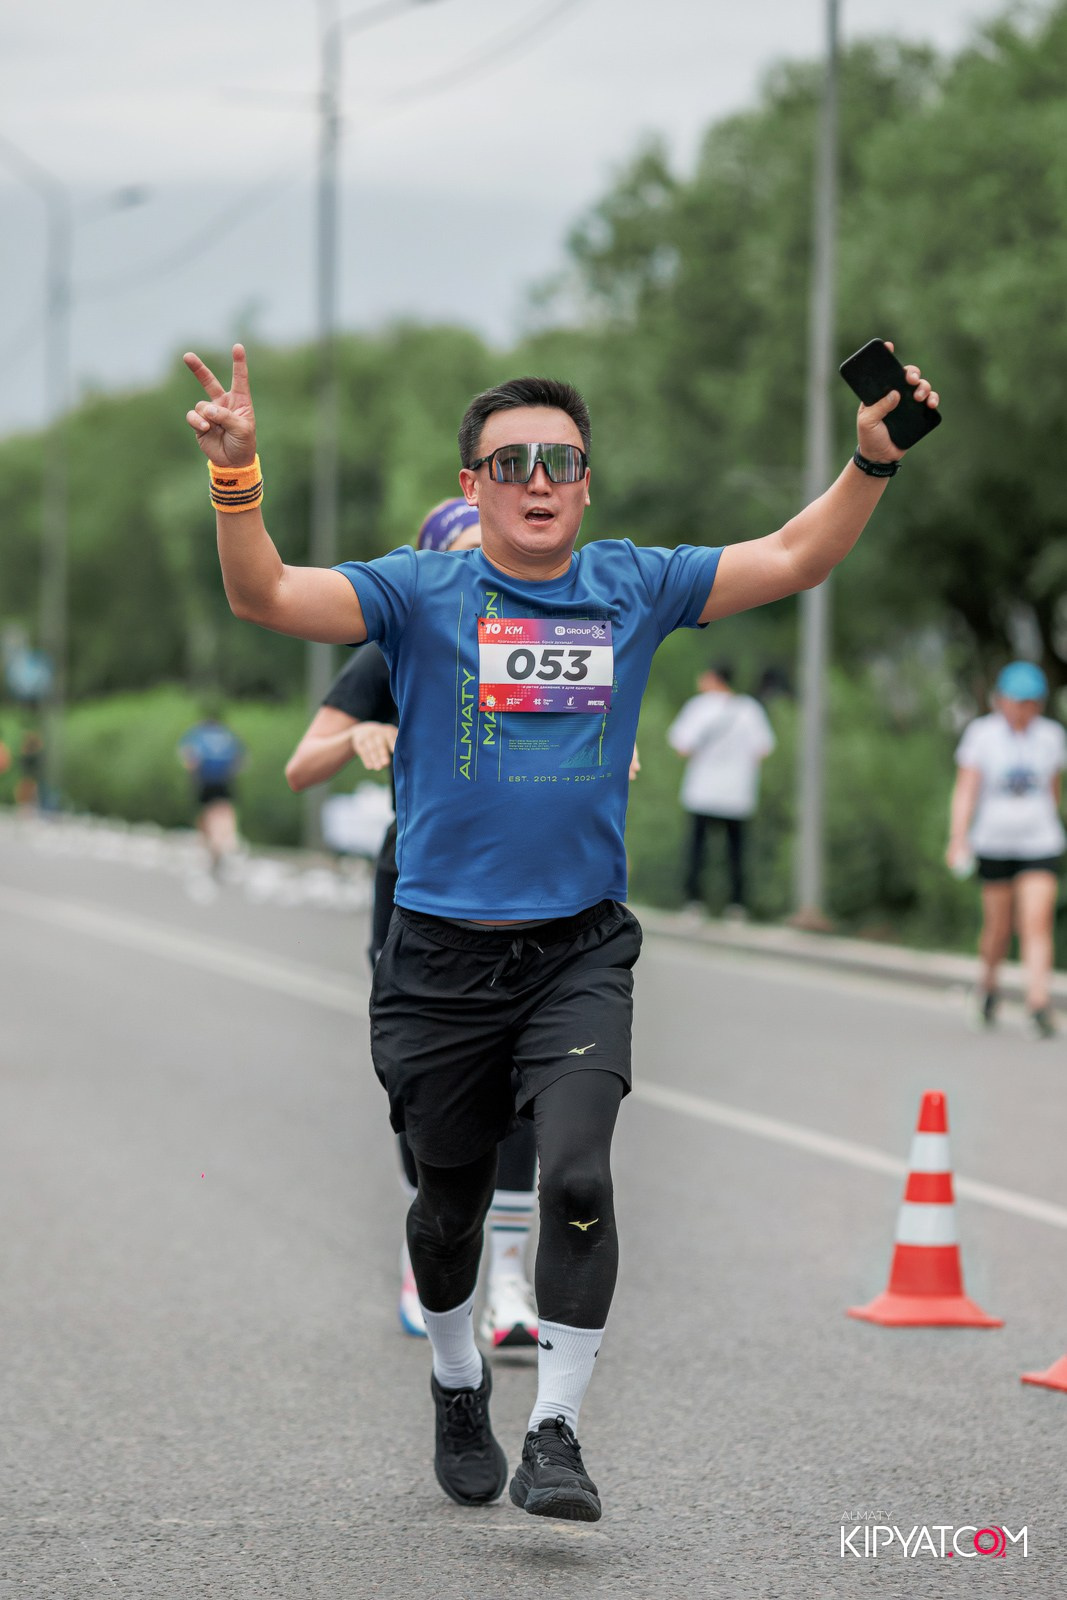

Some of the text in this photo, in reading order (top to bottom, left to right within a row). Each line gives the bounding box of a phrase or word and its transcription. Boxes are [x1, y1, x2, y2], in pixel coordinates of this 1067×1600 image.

[485, 623, 501, 634] 10
[506, 648, 592, 681] 053
[459, 668, 476, 780] ALMATY
